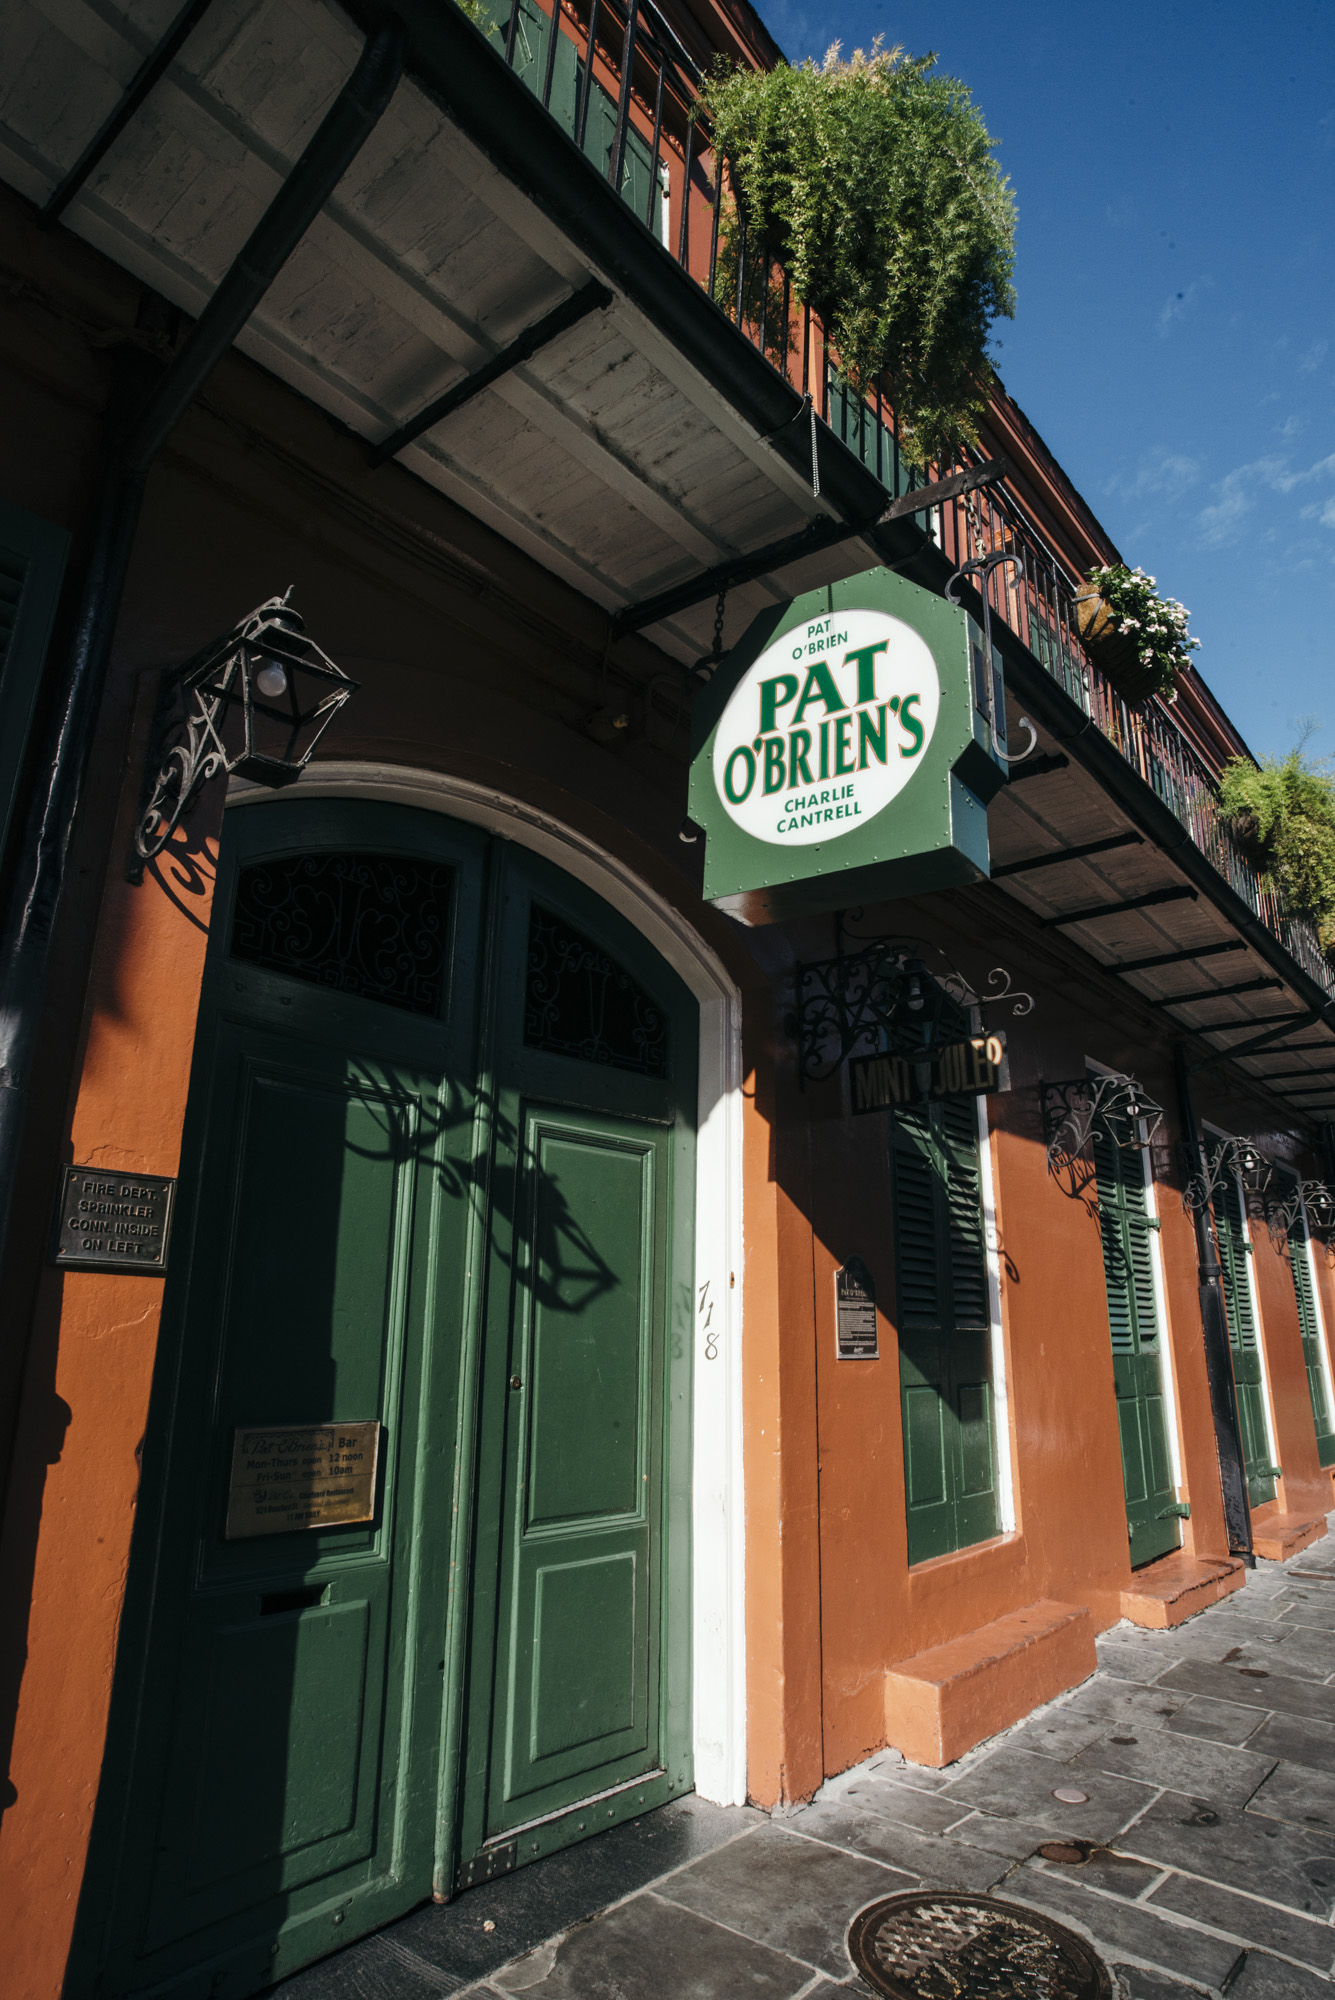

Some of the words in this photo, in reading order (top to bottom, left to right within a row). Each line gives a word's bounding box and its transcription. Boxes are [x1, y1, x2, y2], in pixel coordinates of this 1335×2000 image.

[807, 619, 831, 639] PAT
[791, 631, 849, 660] O'BRIEN
[756, 638, 891, 737] PAT
[723, 692, 926, 806] O'BRIEN'S
[783, 784, 855, 814] CHARLIE
[776, 801, 862, 833] CANTRELL
[855, 1056, 911, 1111] MINT
[933, 1036, 1003, 1095] JULEP
[82, 1181, 116, 1196] FIRE
[120, 1184, 159, 1201] DEPT.
[78, 1199, 155, 1218] SPRINKLER
[68, 1216, 112, 1233] CONN.
[114, 1221, 160, 1238] INSIDE
[81, 1237, 102, 1251] ON
[107, 1239, 144, 1254] LEFT
[338, 1437, 358, 1449] Bar
[246, 1457, 298, 1470] Mon-Thurs
[302, 1457, 322, 1466] open
[329, 1453, 339, 1463] 12
[342, 1452, 363, 1462] noon
[256, 1472, 291, 1483] Fri-Sun
[302, 1470, 322, 1478] open
[329, 1466, 353, 1476] 10am
